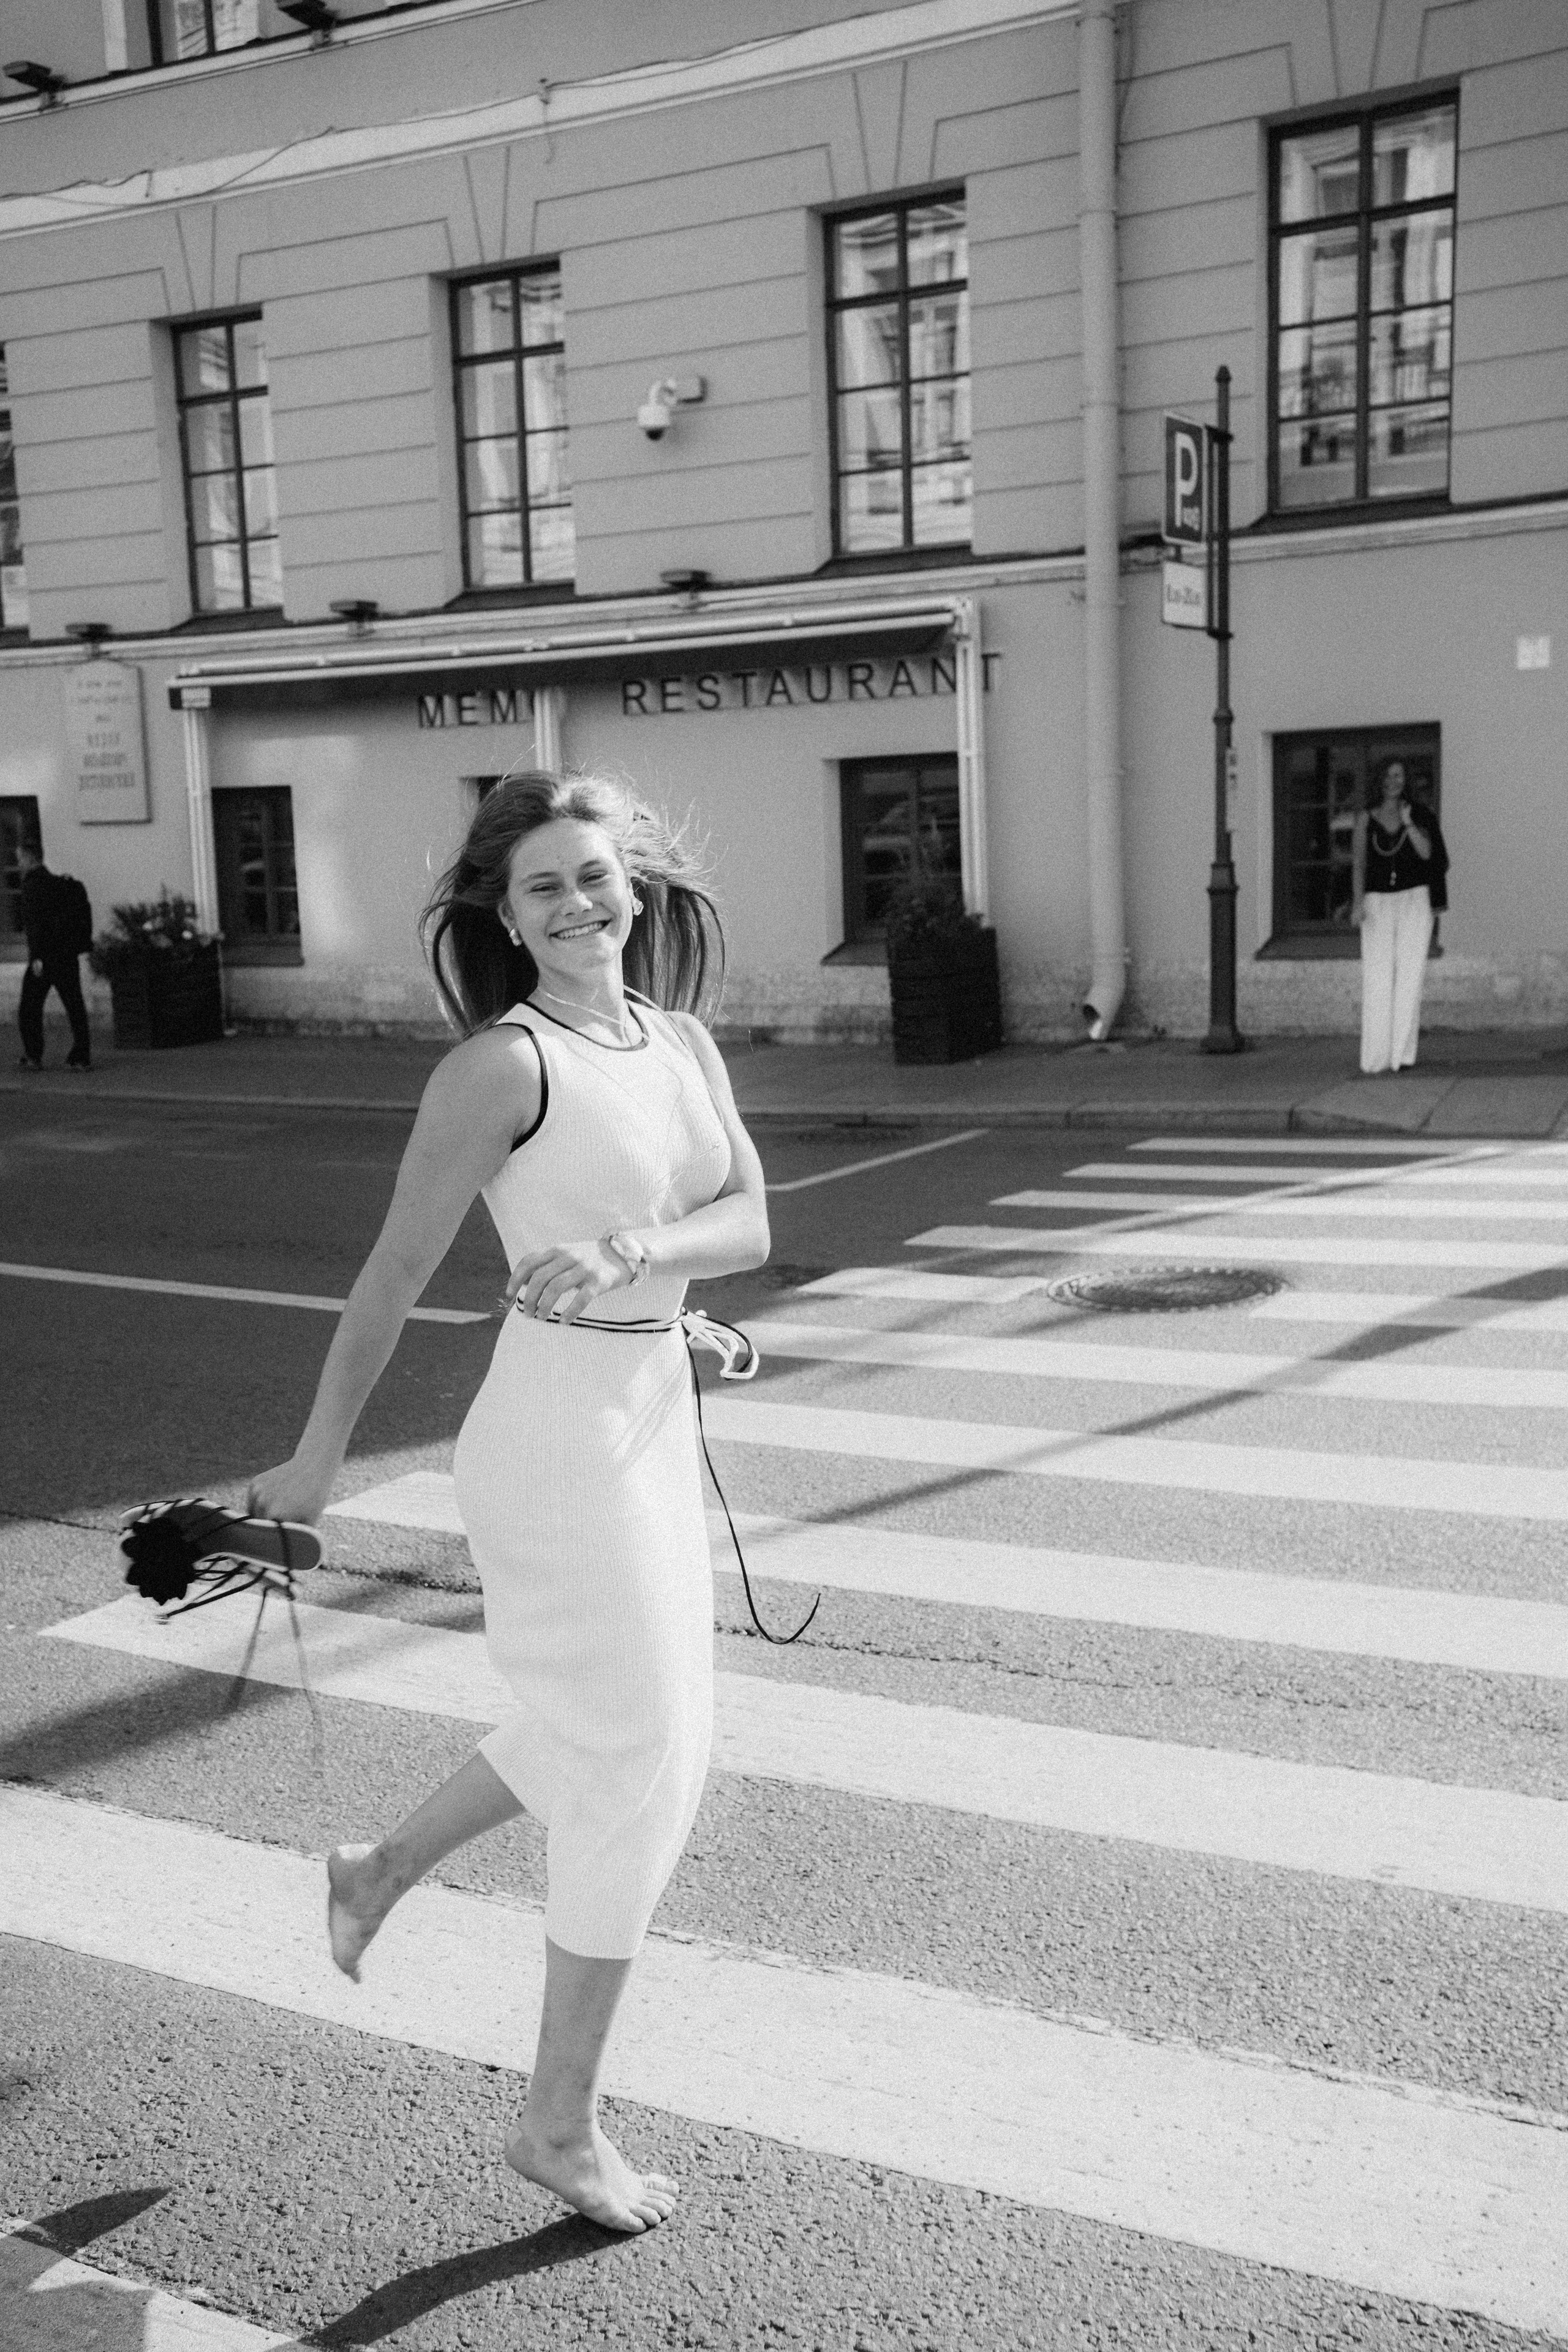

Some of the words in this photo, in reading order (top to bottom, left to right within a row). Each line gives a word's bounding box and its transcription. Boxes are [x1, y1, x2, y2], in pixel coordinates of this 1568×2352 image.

[1175, 432, 1198, 527] P
[417, 688, 535, 728] MEM
[622, 654, 1001, 715] RESTAURANT
